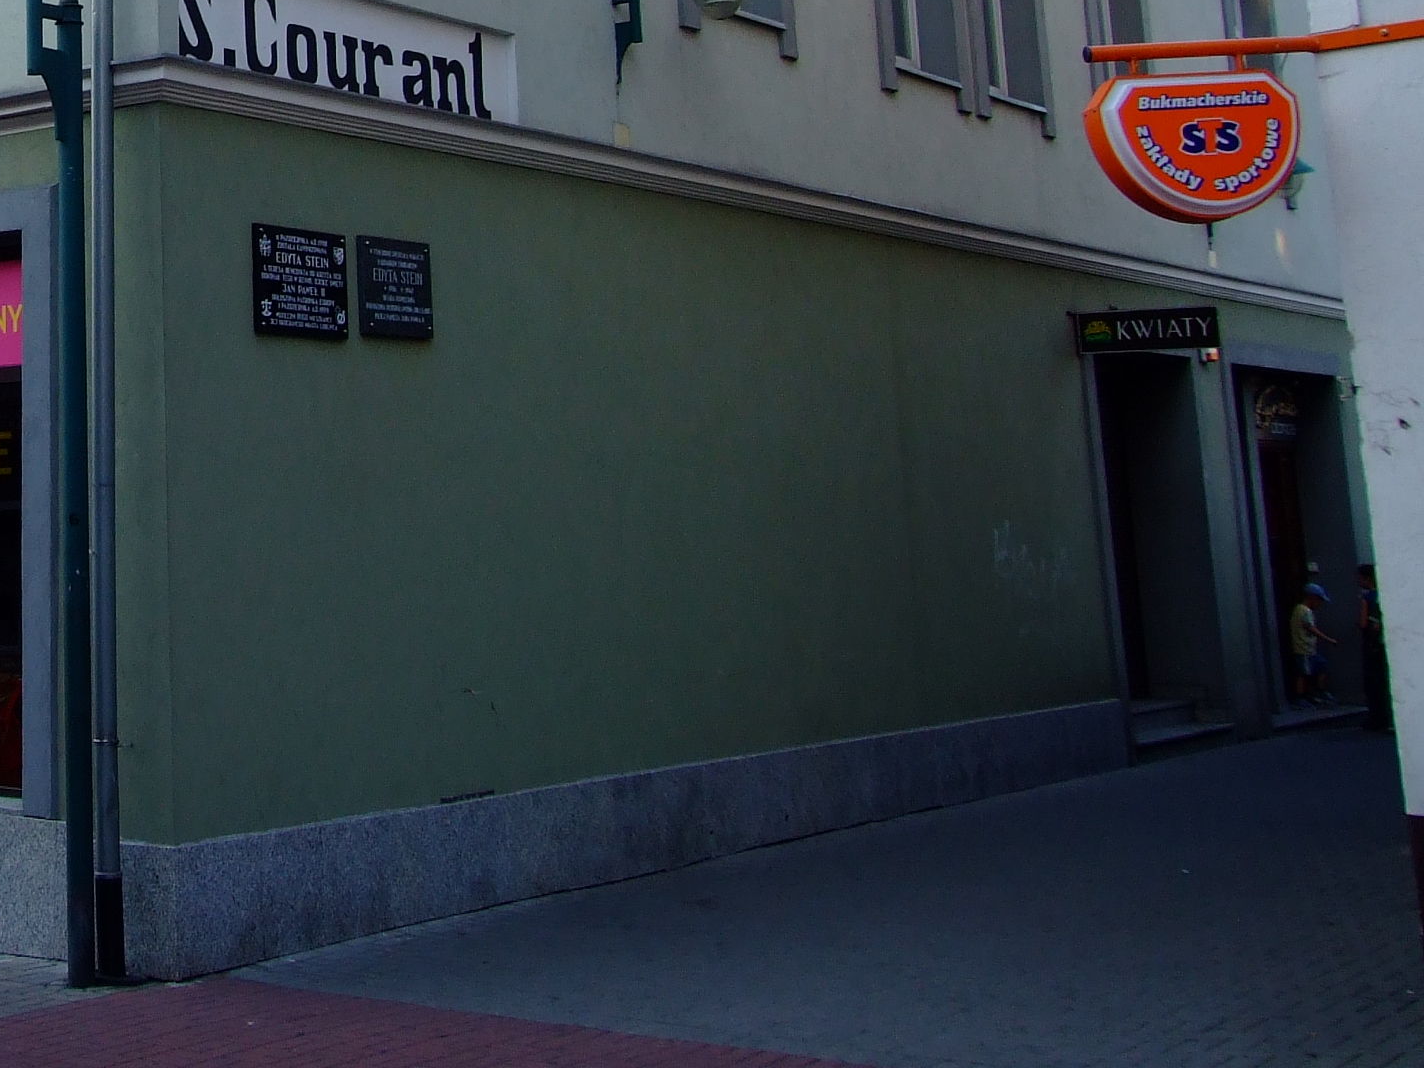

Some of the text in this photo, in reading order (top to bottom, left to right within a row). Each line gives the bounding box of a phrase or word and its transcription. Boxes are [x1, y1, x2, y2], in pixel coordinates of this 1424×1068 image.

[1138, 90, 1269, 111] Bukmacherskie
[1179, 118, 1241, 155] STS
[1136, 118, 1280, 193] zakłady sportowe
[275, 251, 329, 269] EDYTA STEIN
[373, 267, 423, 286] EDYTA STEIN
[282, 283, 296, 293] JAN
[1116, 315, 1212, 341] KWIATY
